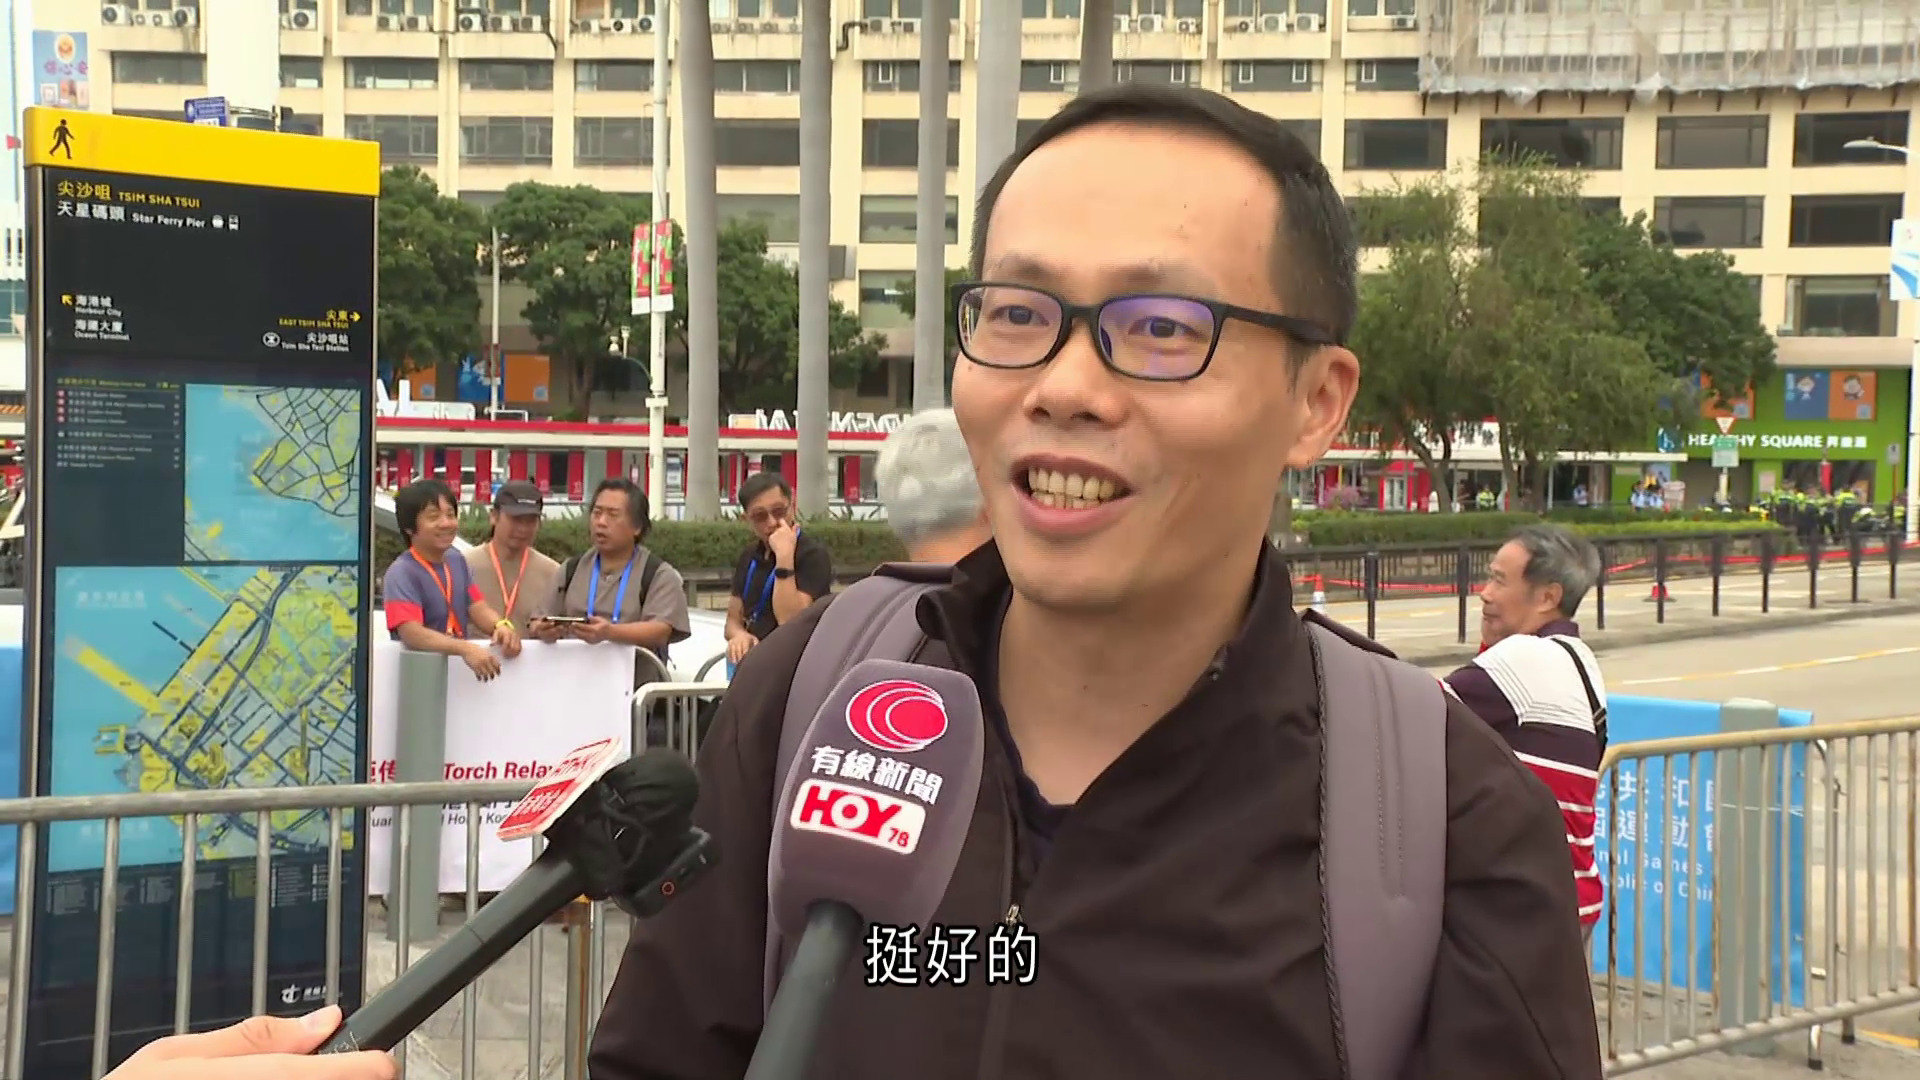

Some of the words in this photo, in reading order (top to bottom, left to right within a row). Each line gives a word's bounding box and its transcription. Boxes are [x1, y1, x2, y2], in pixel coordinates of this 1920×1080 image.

[57, 180, 112, 200] 尖沙咀
[119, 192, 146, 203] TSIM
[149, 194, 172, 206] SHA
[175, 196, 200, 208] TSUI
[57, 200, 125, 221] 天星碼頭
[132, 212, 155, 224] Star
[157, 214, 183, 228] Ferry
[186, 216, 205, 228] Pier
[1760, 435, 1822, 448] SQUARE
[444, 762, 497, 780] Torch
[811, 746, 943, 805] 有線新聞
[799, 785, 902, 838] HOY
[887, 827, 910, 848] 78
